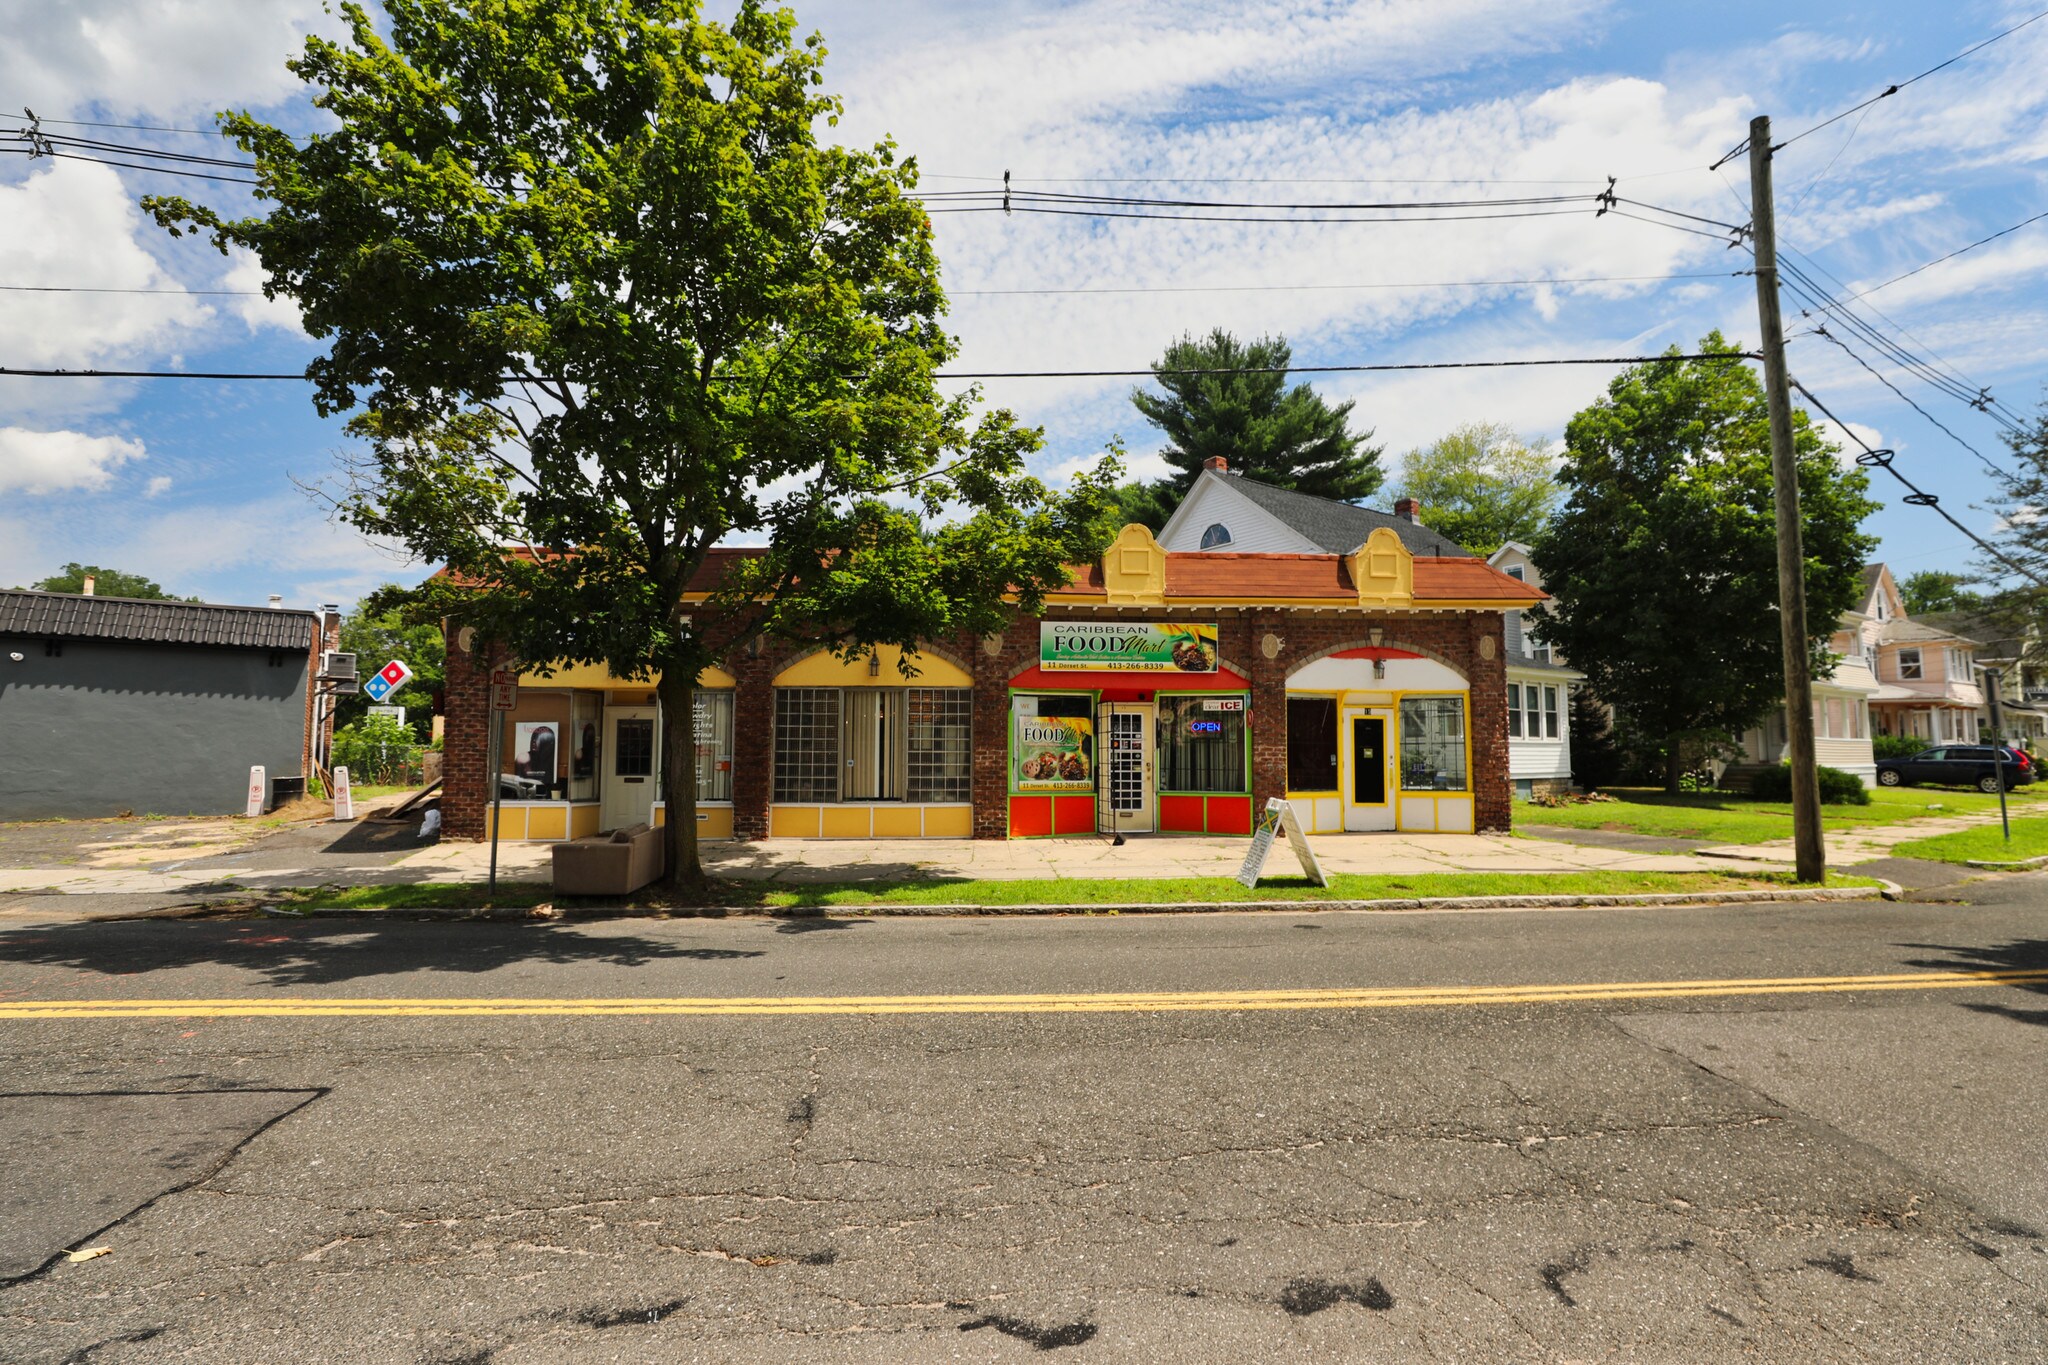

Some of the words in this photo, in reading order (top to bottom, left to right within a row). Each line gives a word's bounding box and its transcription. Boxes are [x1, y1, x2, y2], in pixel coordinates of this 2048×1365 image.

[1054, 625, 1149, 634] CARIBBEAN
[1053, 635, 1125, 652] FOOD
[1107, 662, 1164, 670] 413-266-8339
[495, 673, 505, 683] NO
[1220, 701, 1241, 710] ICE
[1191, 722, 1221, 731] OPEN
[1024, 727, 1064, 742] FOOD
